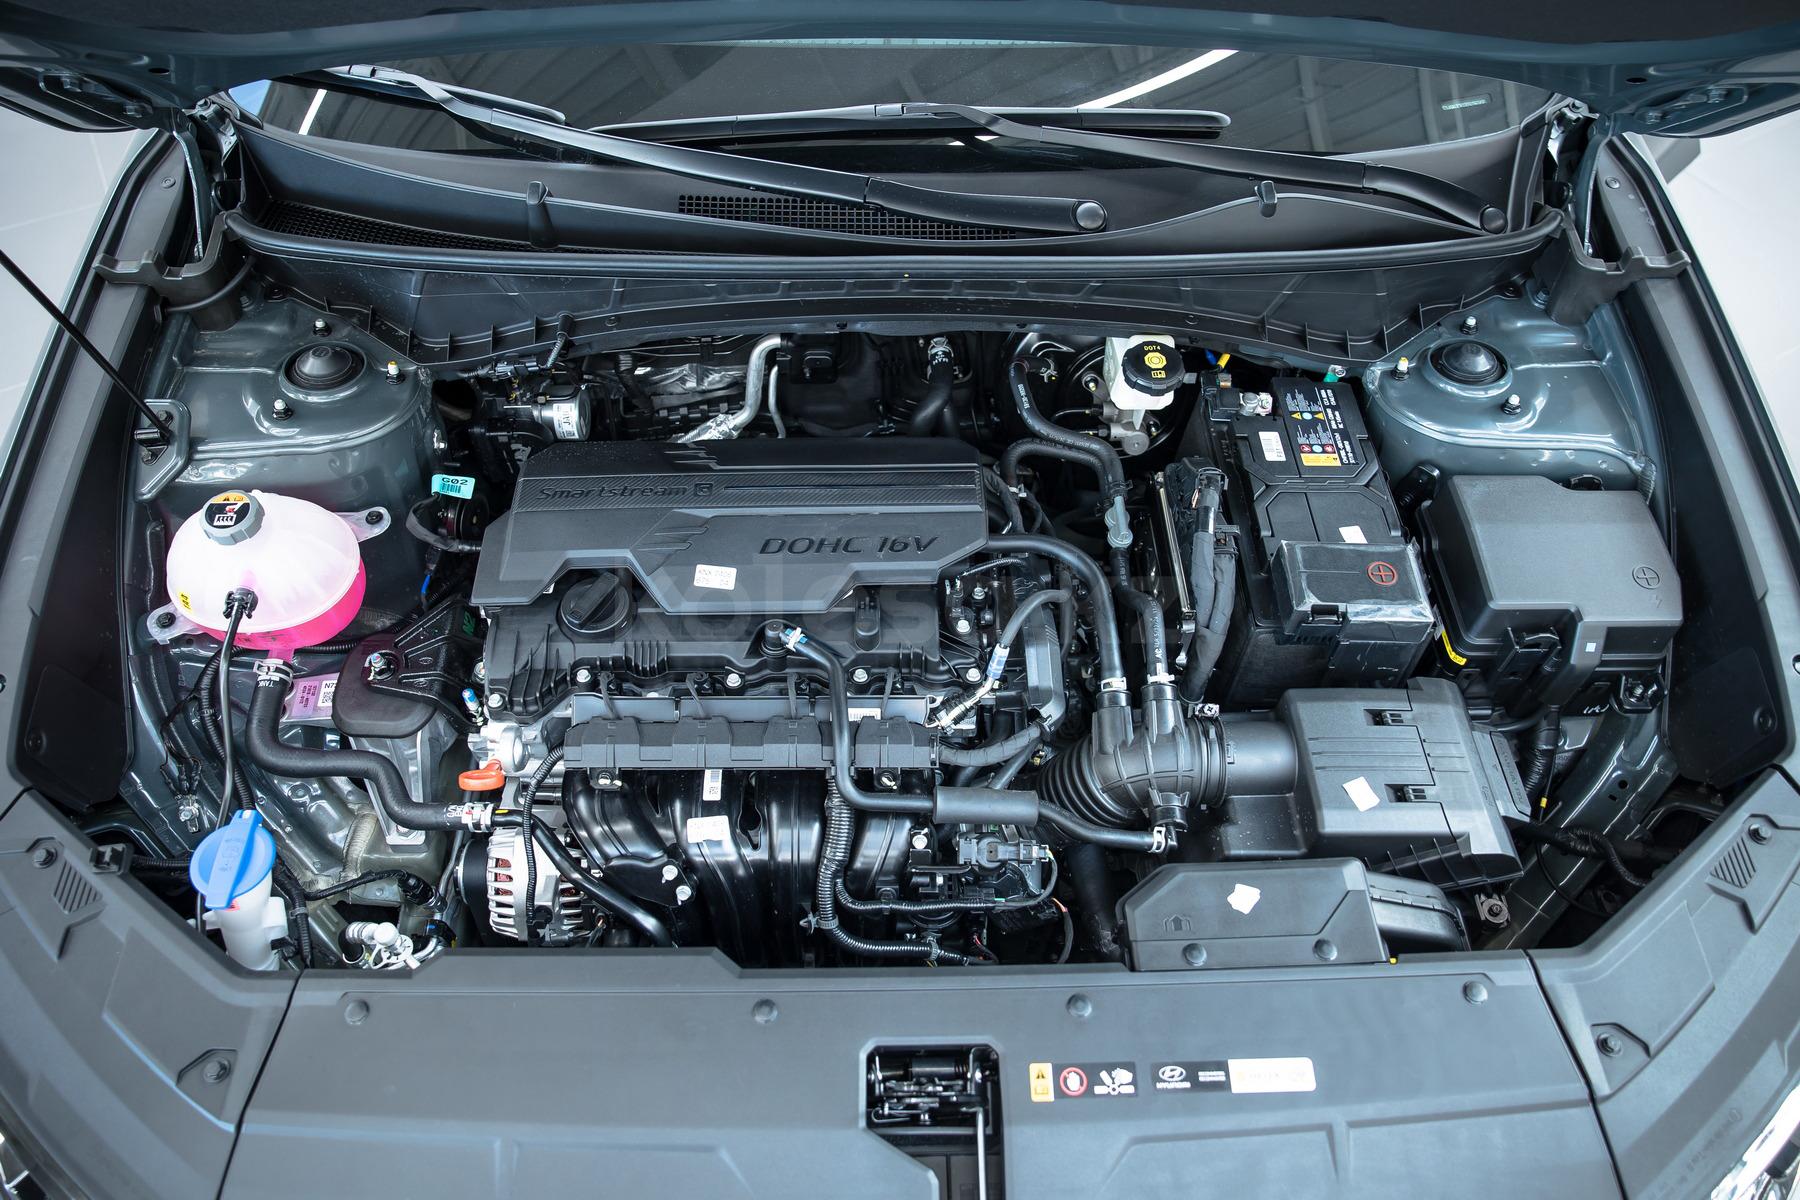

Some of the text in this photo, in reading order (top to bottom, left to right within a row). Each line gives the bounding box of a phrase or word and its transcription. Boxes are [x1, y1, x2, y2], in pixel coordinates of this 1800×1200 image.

[536, 485, 689, 501] Smartstream
[759, 536, 940, 555] DOHC 16V
